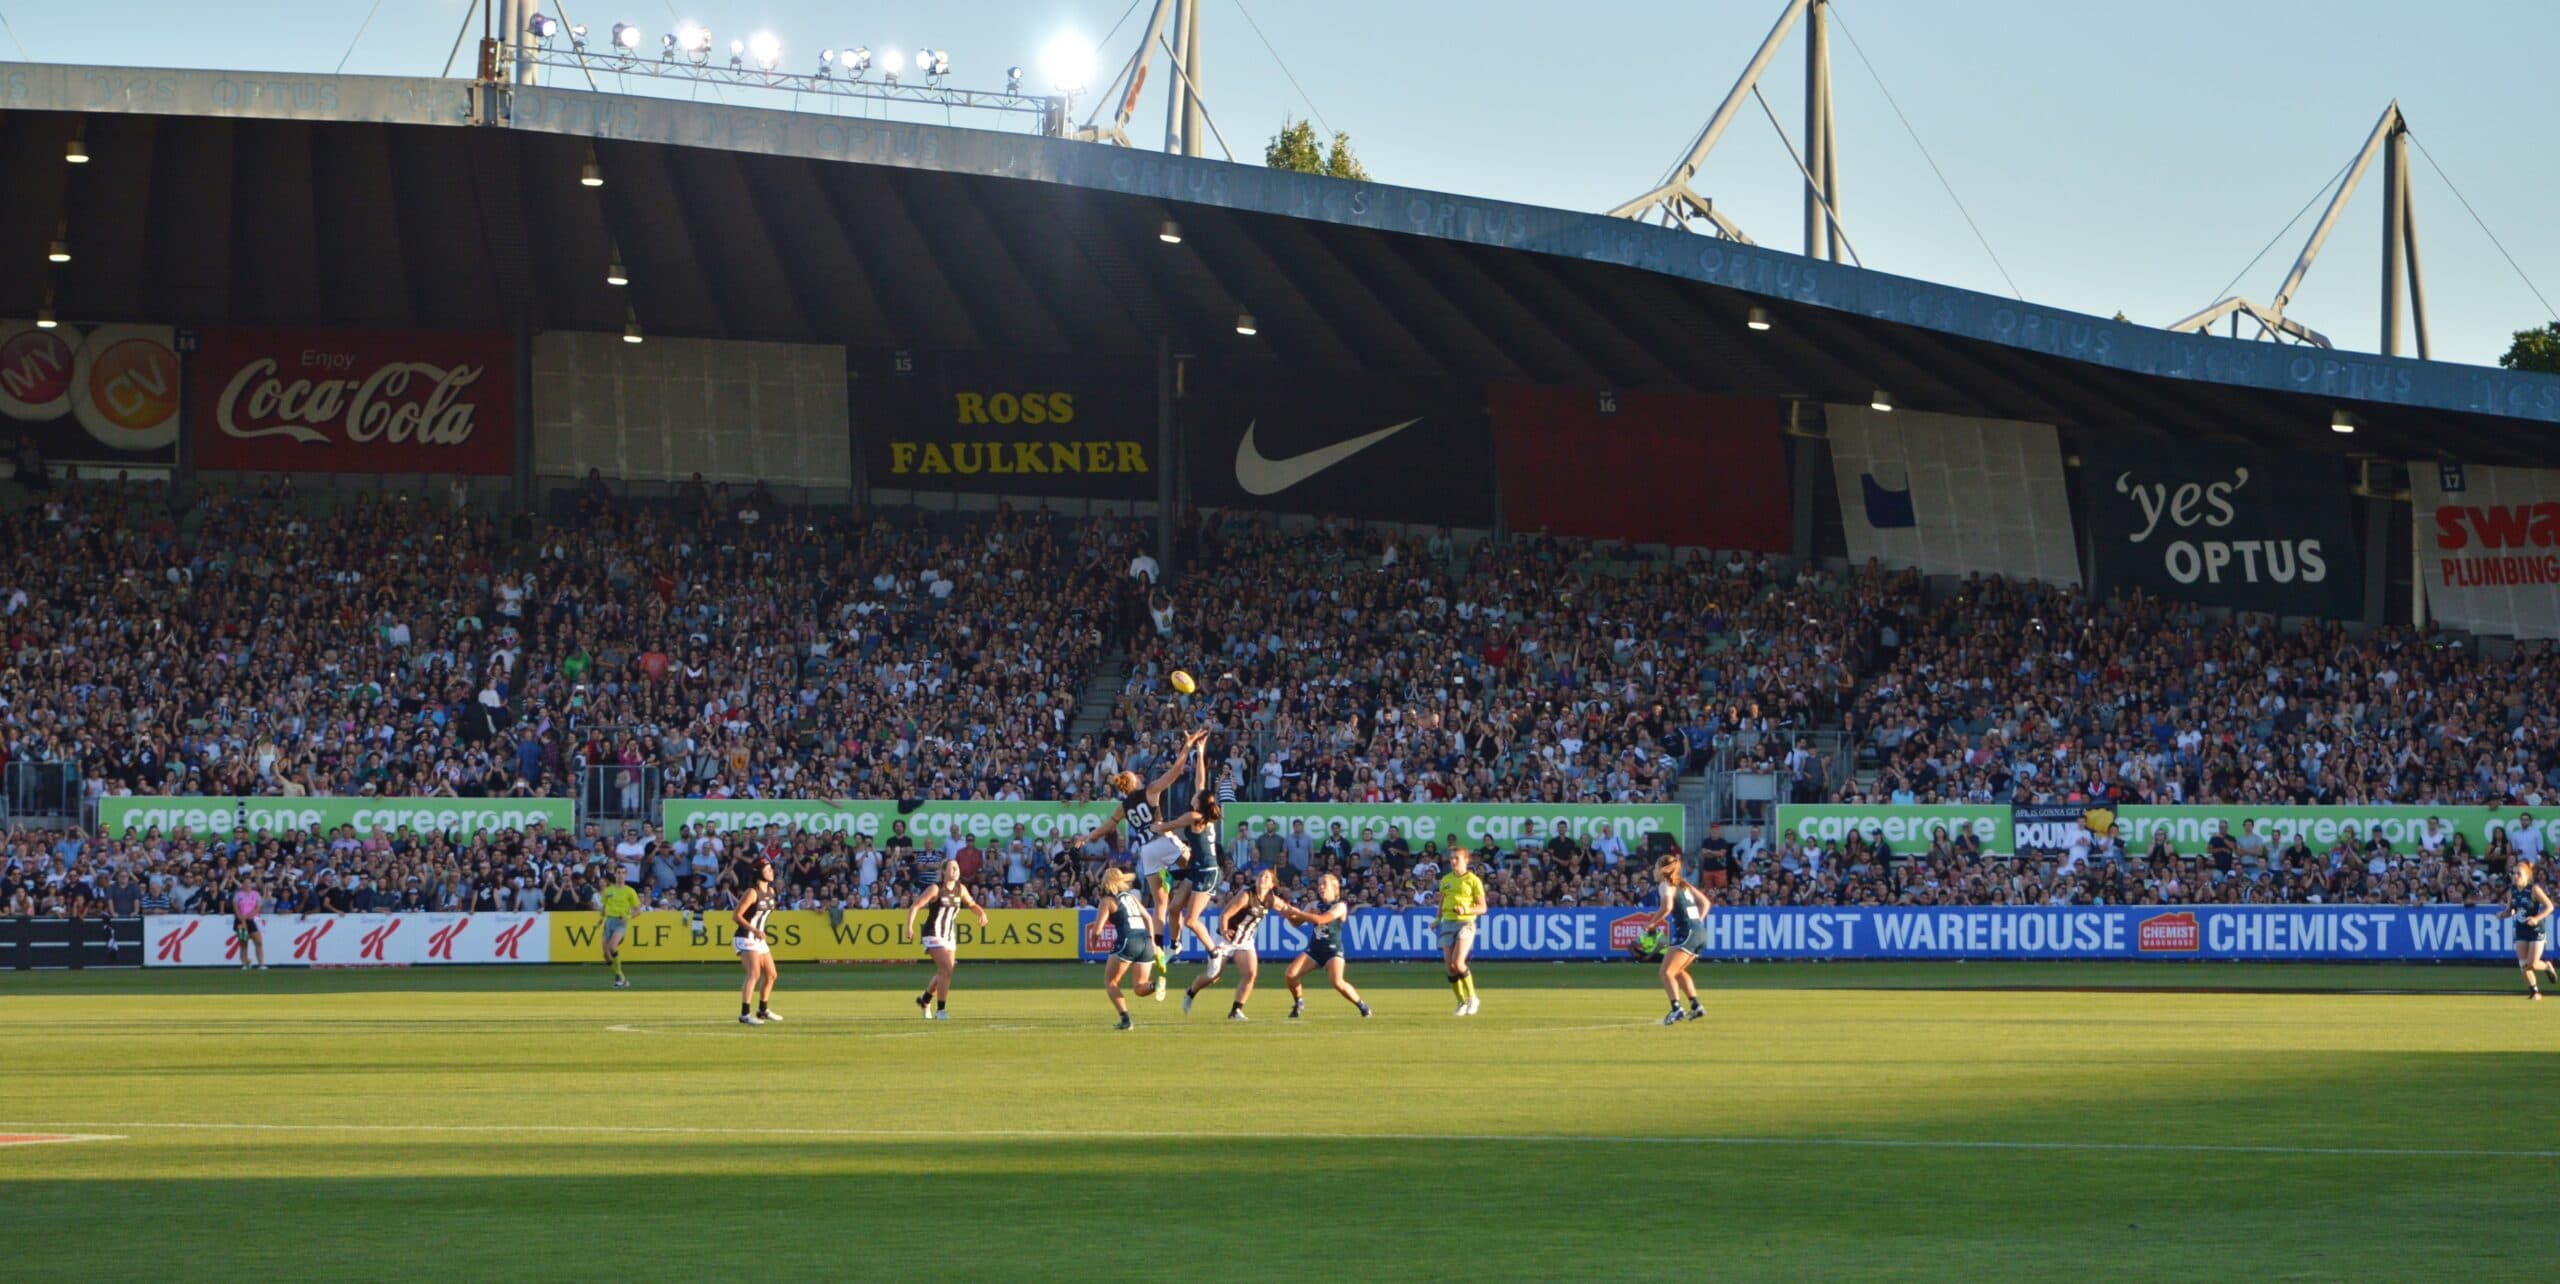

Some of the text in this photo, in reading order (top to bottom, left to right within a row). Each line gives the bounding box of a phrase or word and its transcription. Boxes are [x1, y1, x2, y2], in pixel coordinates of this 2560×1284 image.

[301, 349, 356, 369] Enjoy
[2, 339, 168, 417] MY CV
[216, 357, 484, 444] Coca-Cola
[955, 392, 1075, 424] ROSS
[890, 441, 1149, 474] FAULKNER
[2445, 474, 2460, 489] 17
[2164, 539, 2327, 584] OPTUS
[2441, 554, 2560, 587] PLUMBING
[1127, 802, 1153, 828] 60
[565, 924, 802, 946] WLF BLSS
[831, 923, 926, 945] WOL
[956, 922, 1065, 945] BLASS
[1348, 913, 1597, 951] WARHOUSE
[1706, 913, 2126, 951] HEMIST WAREHOUSE
[2143, 926, 2196, 938] CHEMIST
[2208, 913, 2396, 952] CHEMIST
